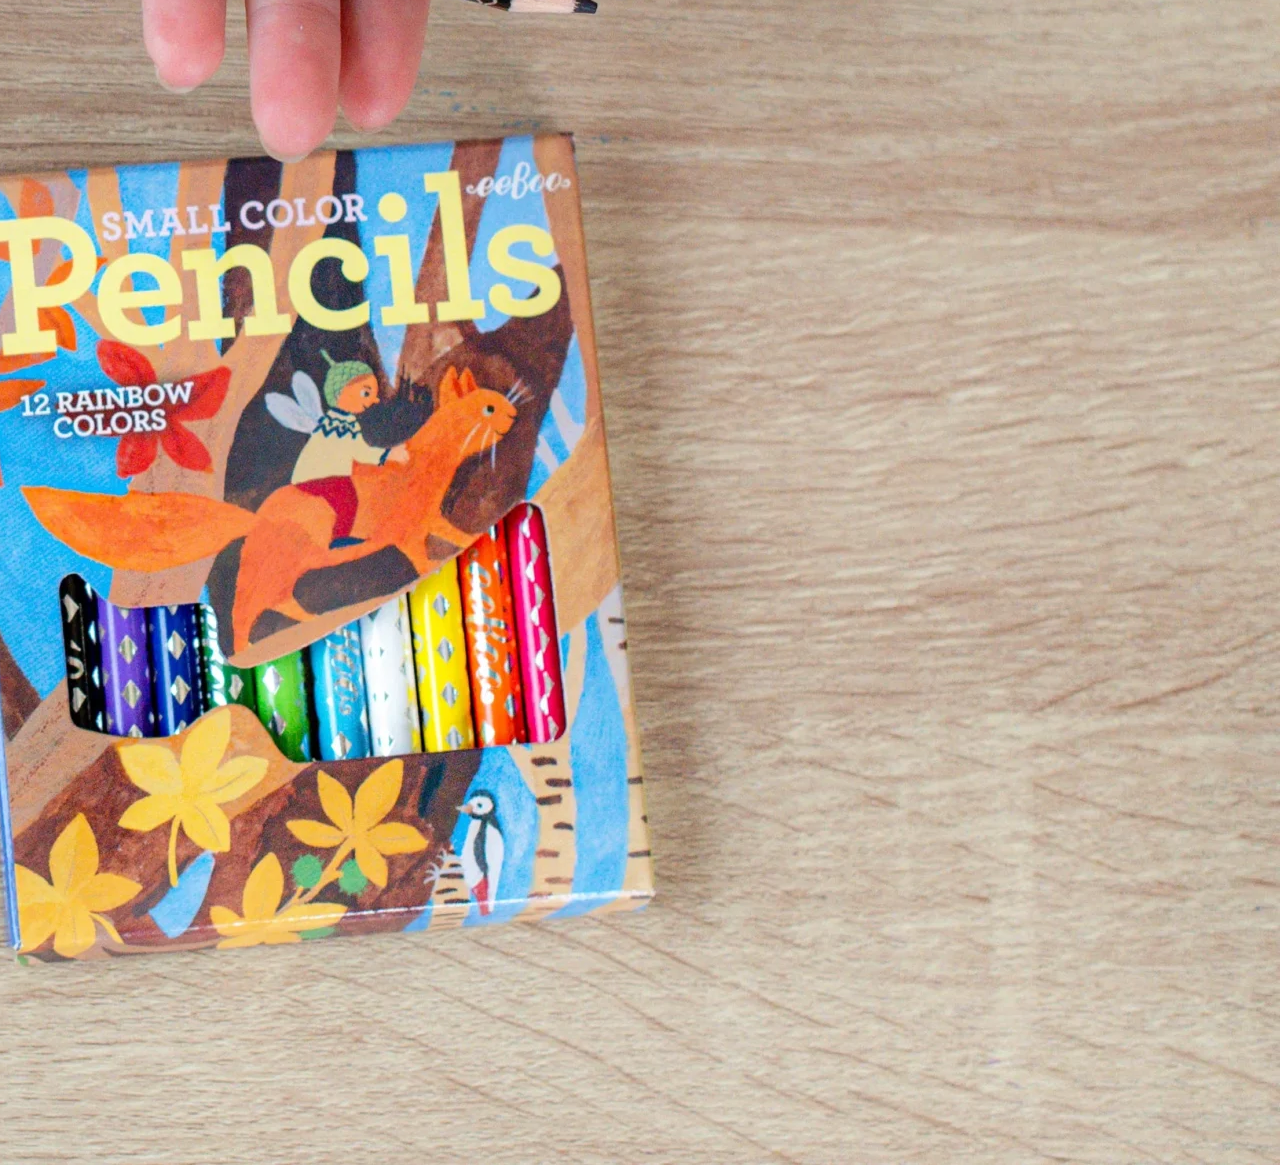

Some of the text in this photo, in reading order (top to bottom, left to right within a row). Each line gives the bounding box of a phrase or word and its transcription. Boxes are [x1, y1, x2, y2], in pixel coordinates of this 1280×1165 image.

[465, 161, 572, 200] eeboo
[101, 194, 368, 242] SMALL COLOR
[20, 381, 195, 417] 12 RAINBOW
[53, 409, 167, 439] COLORS
